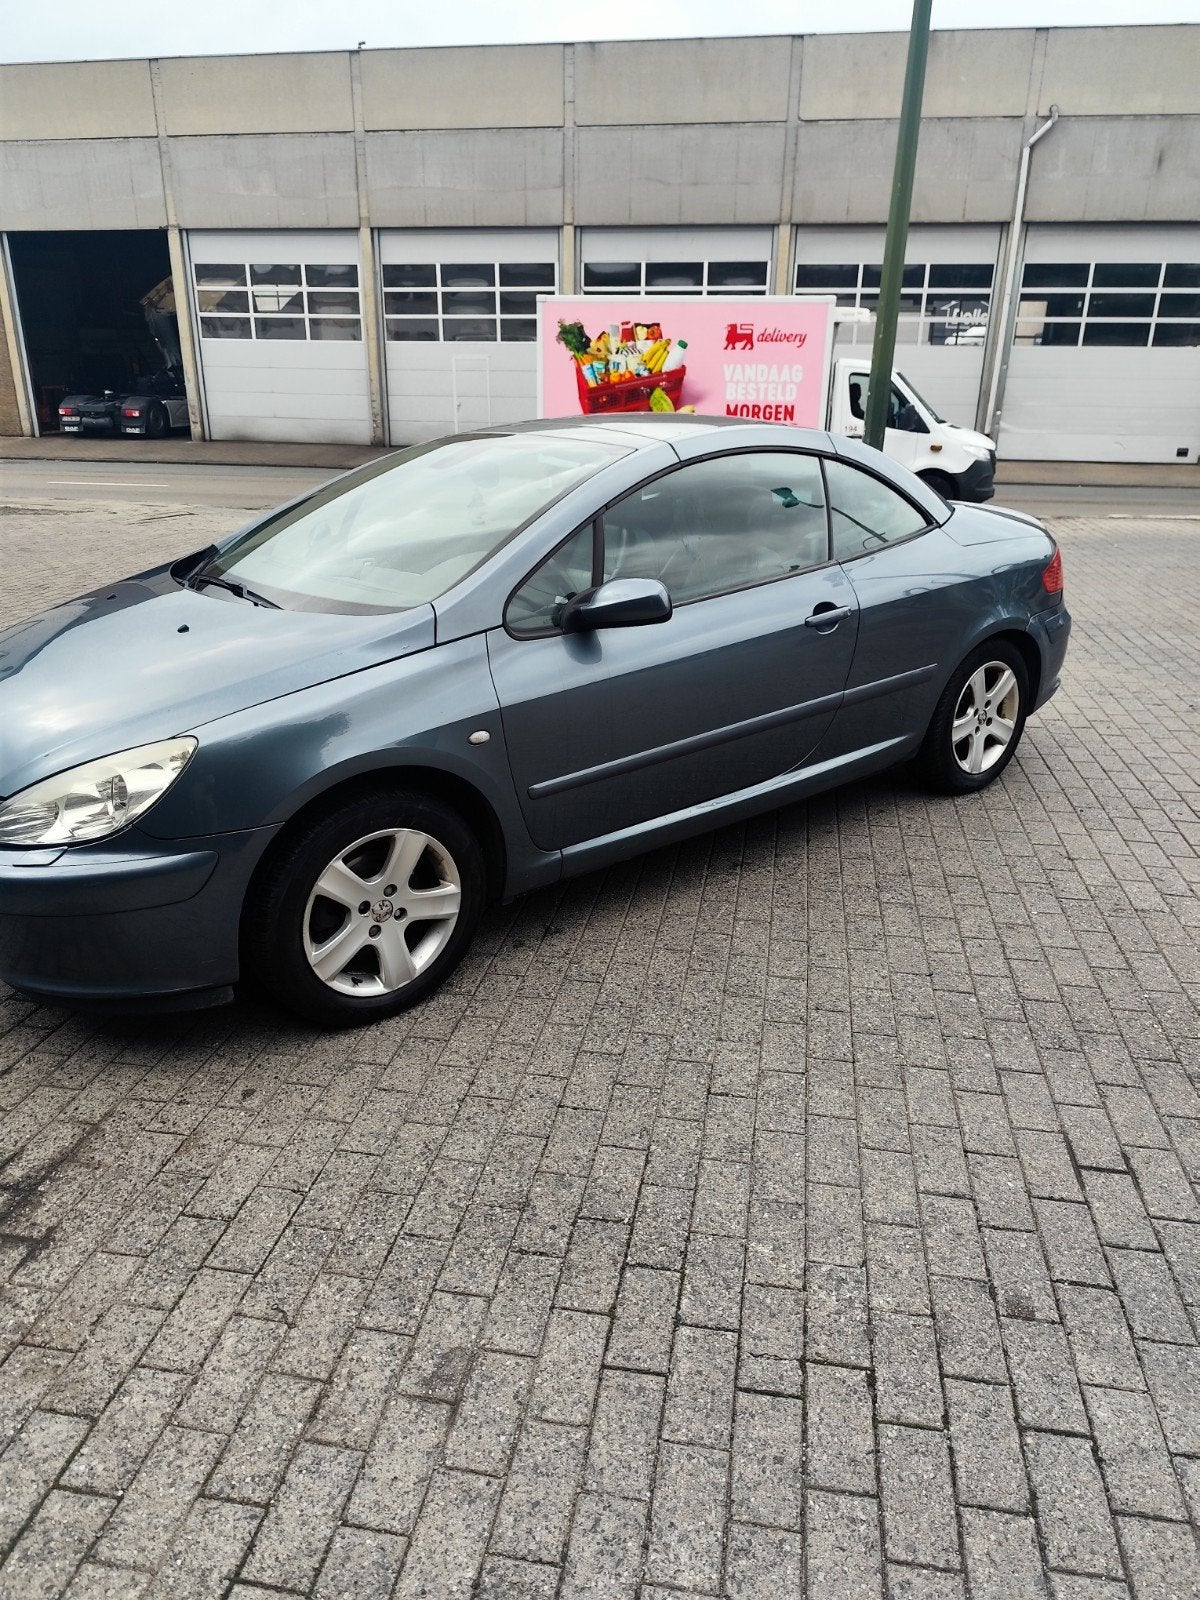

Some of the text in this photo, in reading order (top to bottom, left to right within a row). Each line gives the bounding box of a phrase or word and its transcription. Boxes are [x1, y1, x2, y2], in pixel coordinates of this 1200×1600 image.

[757, 328, 807, 348] delivery
[723, 364, 803, 382] VANDAAG
[726, 383, 797, 400] BESTELD
[726, 404, 795, 421] MORGEN
